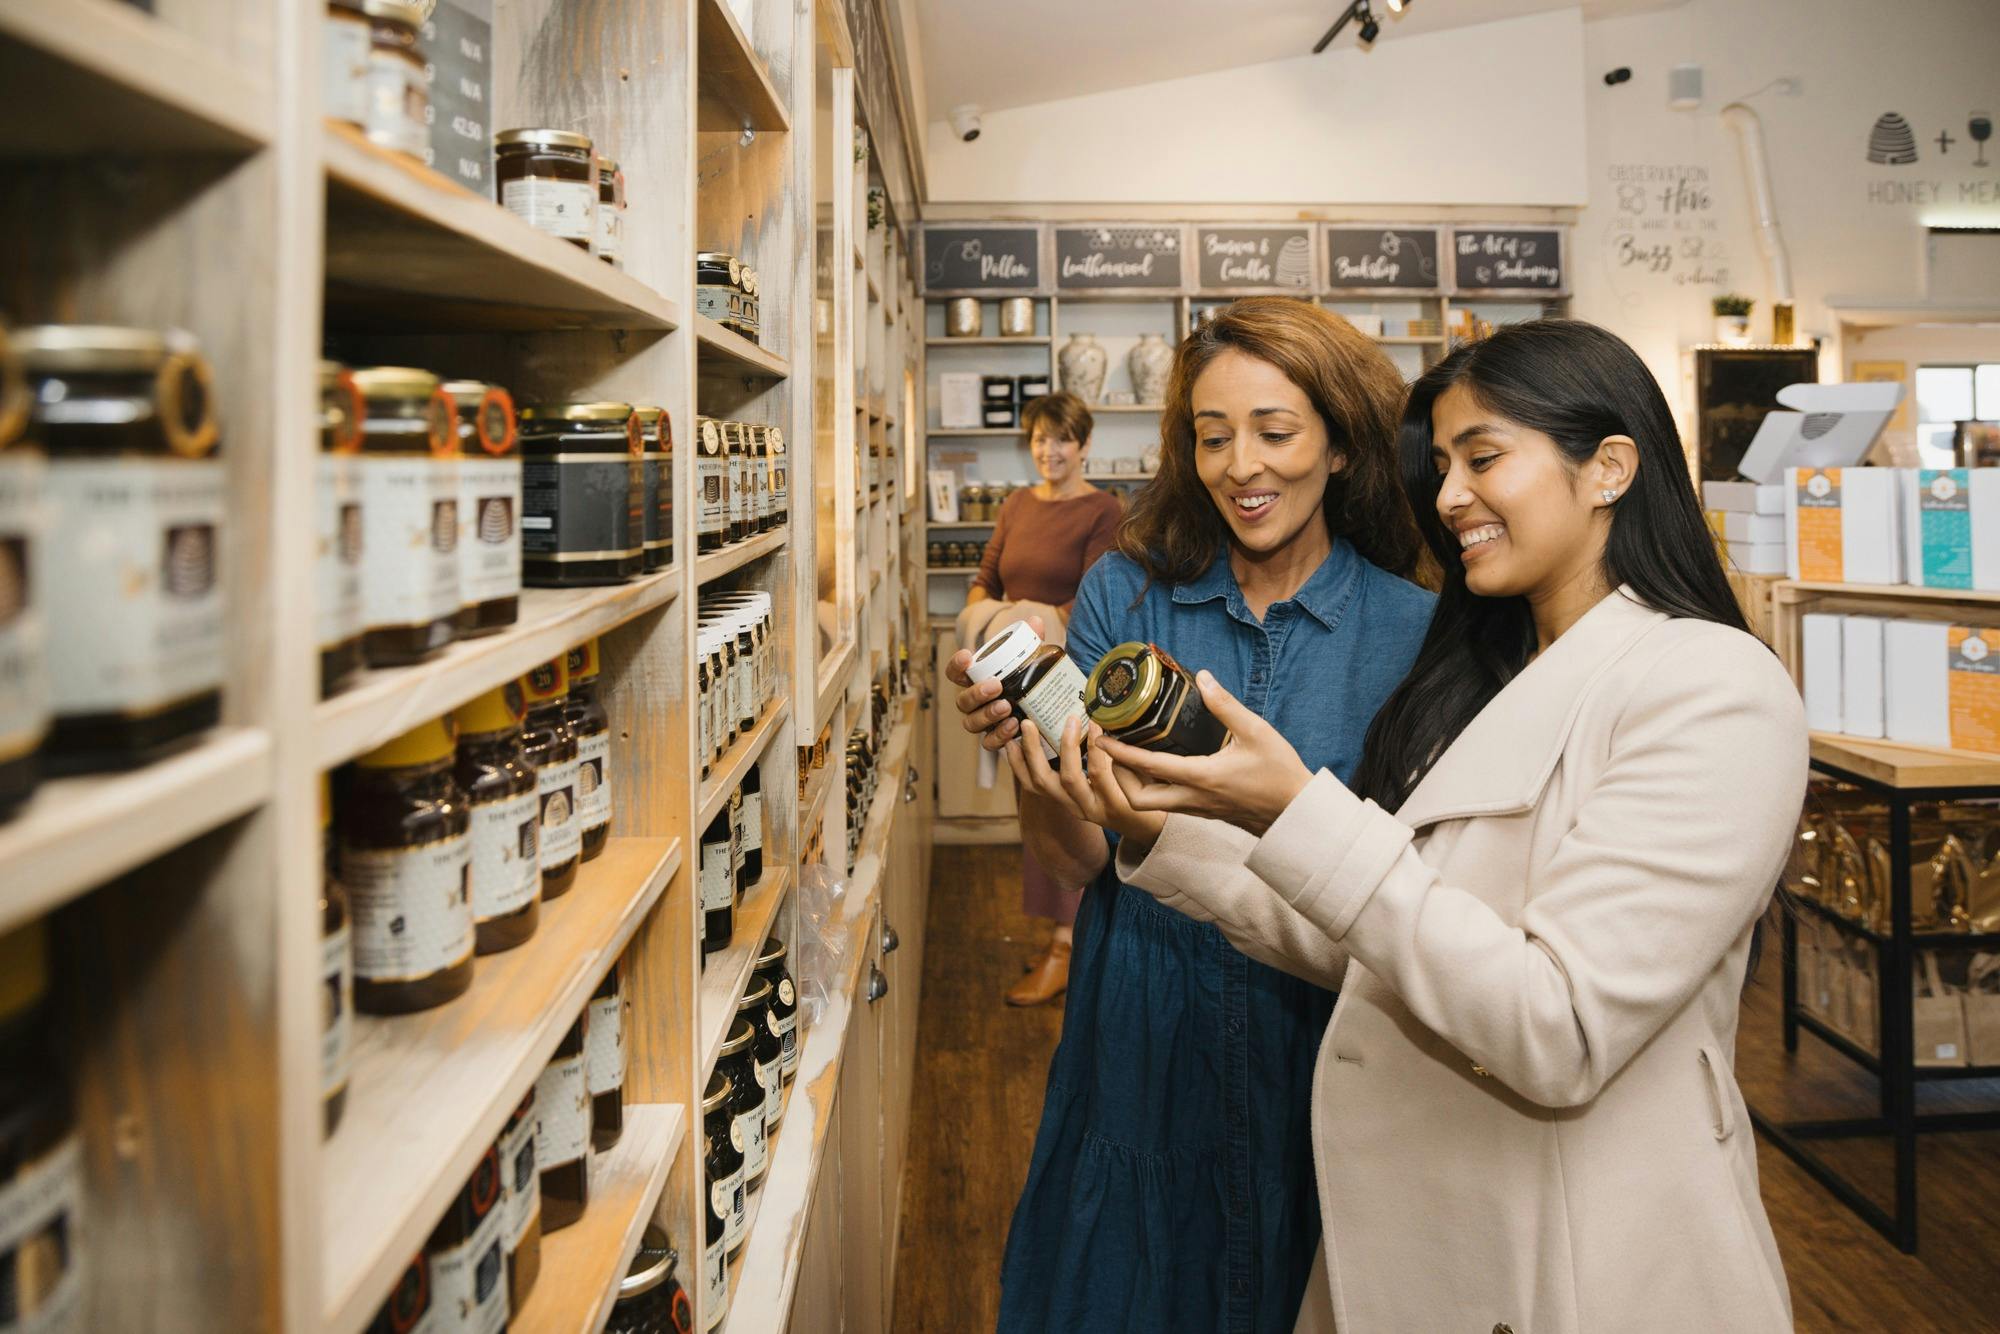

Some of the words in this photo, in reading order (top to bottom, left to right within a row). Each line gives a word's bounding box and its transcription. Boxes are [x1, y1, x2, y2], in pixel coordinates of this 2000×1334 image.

[460, 38, 482, 62] N/A
[460, 78, 482, 101] N/A
[459, 158, 481, 180] N/A
[1656, 178, 1712, 214] Hive
[1867, 180, 1941, 205] HONEY
[1457, 234, 1479, 255] The
[1483, 234, 1503, 254] Art
[1613, 234, 1673, 271] Buzz
[981, 254, 1029, 281] Pollen
[1062, 252, 1153, 278] Leatherwood
[1335, 254, 1400, 282] Bookshop
[537, 672, 552, 688] 20
[748, 1114, 757, 1123] THE
